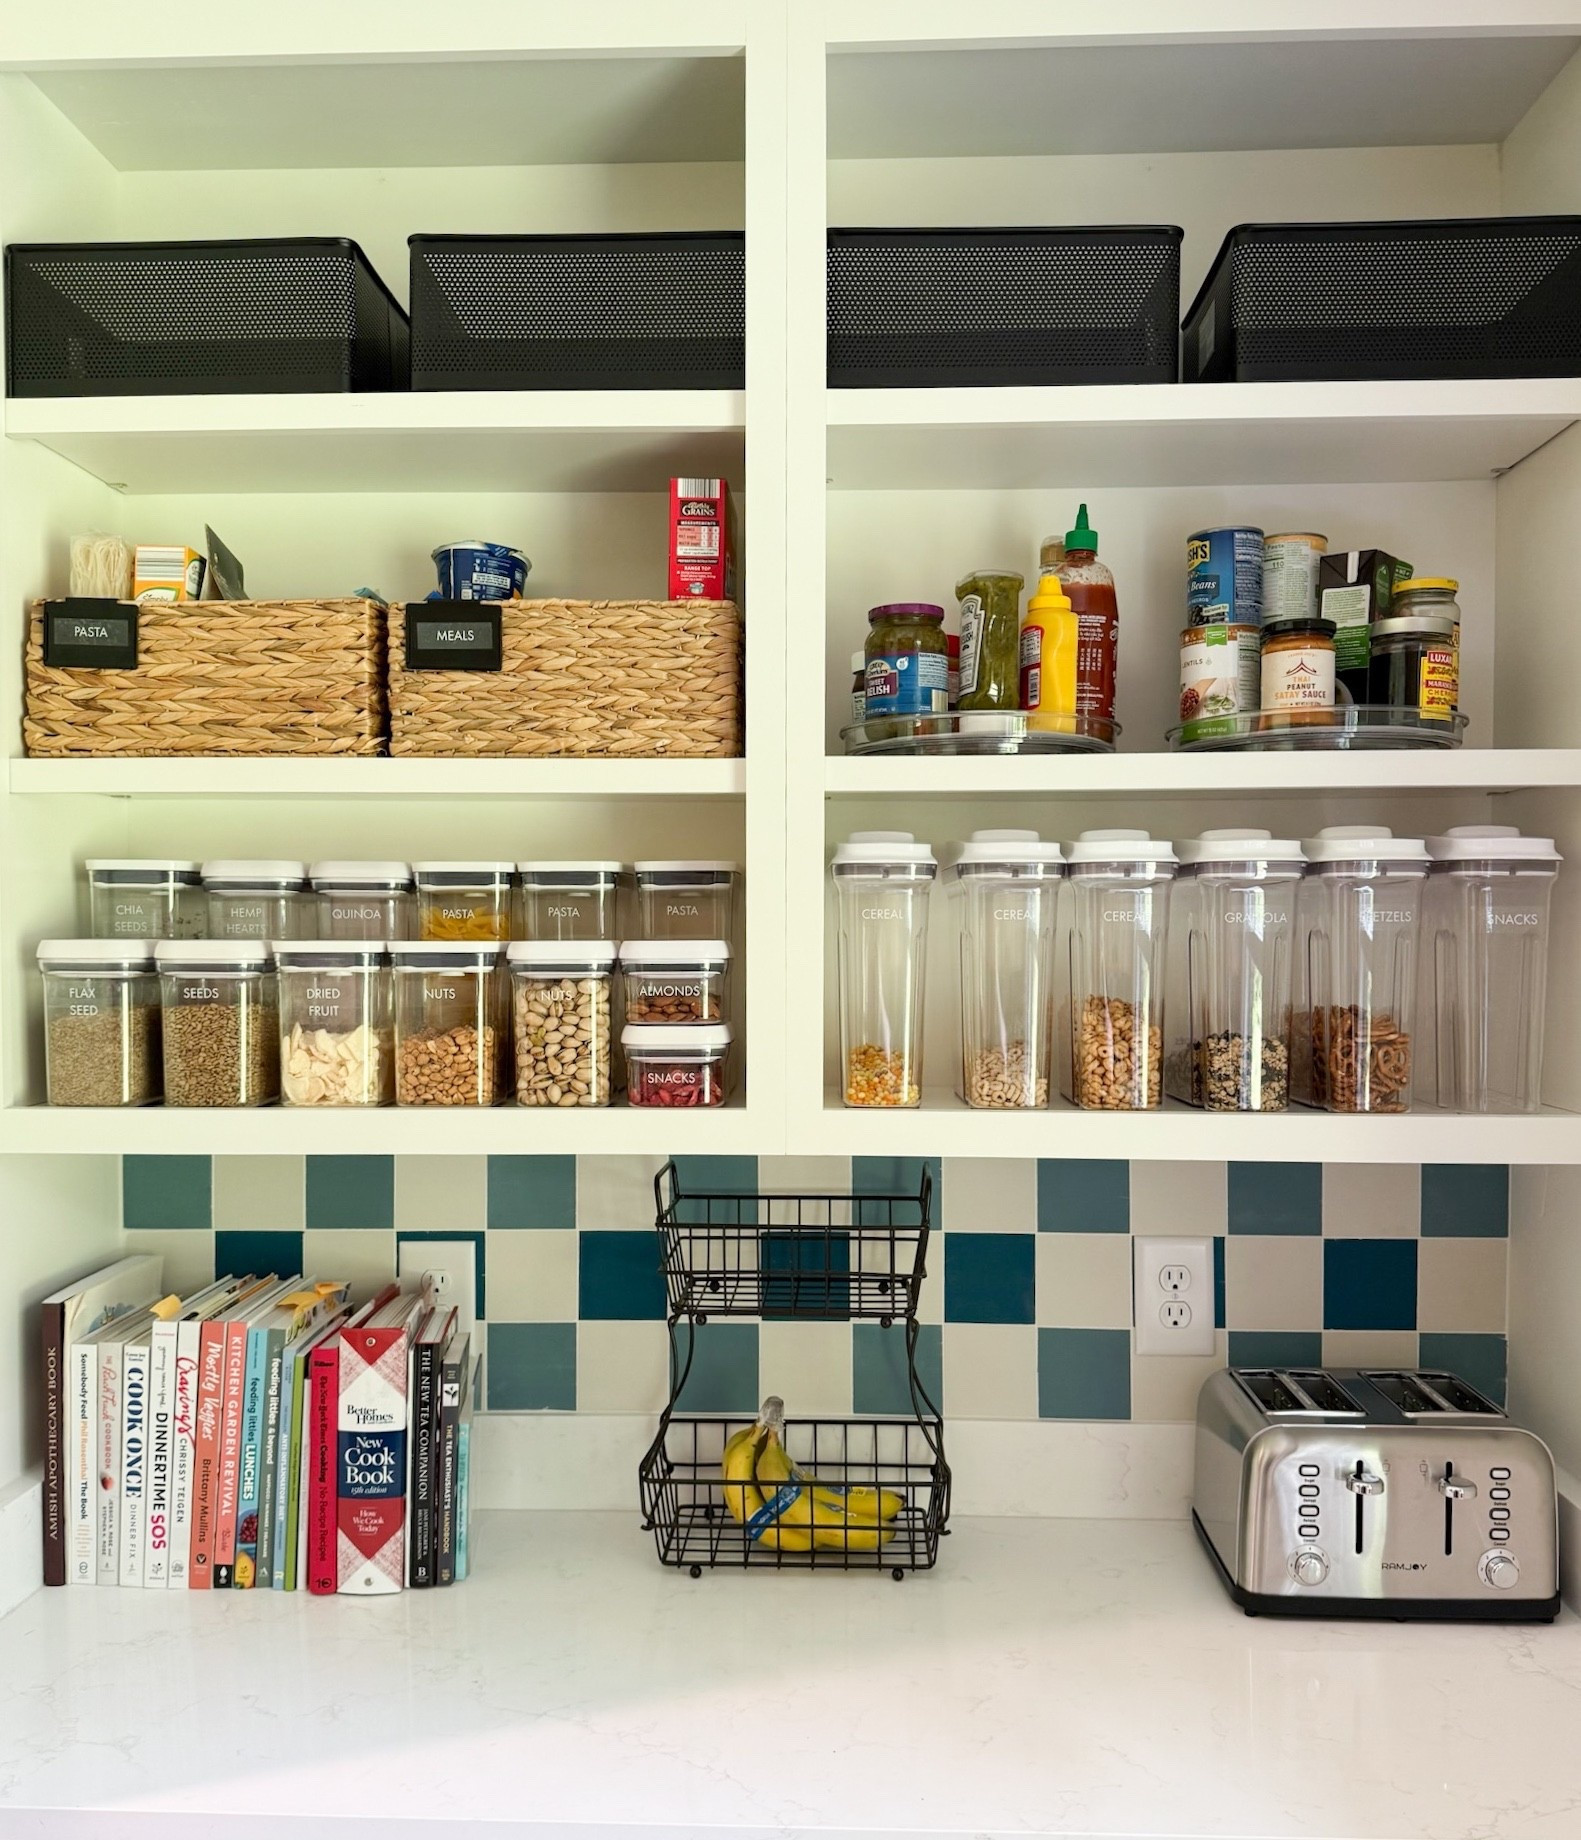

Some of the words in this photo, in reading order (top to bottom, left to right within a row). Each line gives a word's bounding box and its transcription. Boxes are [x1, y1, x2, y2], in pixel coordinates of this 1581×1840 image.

[1188, 544, 1208, 562] SH'S
[1191, 581, 1217, 592] Beans
[74, 626, 108, 638] PASTA
[436, 630, 475, 642] MEALS
[1274, 691, 1300, 700] SATAY
[1302, 690, 1327, 699] SAUCE
[116, 905, 143, 915] CHIA
[230, 907, 263, 918] HEMP
[332, 908, 381, 920] QUINOA
[442, 908, 475, 919] PASTA
[548, 907, 580, 917] PASTA
[666, 905, 698, 916] PASTA
[861, 908, 904, 920] CEREAL
[993, 909, 1037, 920] CEREA
[1103, 910, 1147, 921] CEREA
[1224, 911, 1288, 923] GRAOLA
[1361, 910, 1412, 922] ETZELS
[114, 921, 147, 932] SEEDS
[1487, 913, 1538, 925] SNACKS
[226, 923, 266, 935] HEARTS
[69, 988, 96, 999] FLAX
[183, 987, 219, 999] SEEDS
[306, 988, 341, 1000] DRIED
[425, 988, 456, 999] NUTS
[541, 990, 573, 1001] NUTS
[639, 985, 701, 997] ALMONDS
[69, 1005, 98, 1016] SEED
[308, 1005, 340, 1017] FRUIT
[647, 1072, 696, 1084] SNACKS
[47, 1346, 57, 1388] BOOK
[203, 1341, 223, 1391] Mostly
[229, 1336, 242, 1396] KITCHEN
[421, 1350, 431, 1373] THE
[80, 1353, 88, 1398] Somebody
[268, 1358, 281, 1395] feeding
[319, 1375, 329, 1389] The
[247, 1377, 260, 1413] feeding
[319, 1389, 328, 1405] New
[420, 1376, 430, 1403] NEW
[126, 1367, 144, 1433] COOK
[174, 1357, 198, 1448] Cravings
[80, 1399, 88, 1419] Feed
[267, 1397, 280, 1425] littles
[318, 1405, 328, 1423] York
[347, 1404, 378, 1416] Better
[419, 1406, 429, 1427] TEA
[199, 1397, 220, 1441] Veggies
[356, 1413, 394, 1425] Homes
[80, 1420, 88, 1436] Phil
[224, 1400, 239, 1456] GARDEN
[247, 1416, 258, 1442] littles
[319, 1423, 328, 1444] Times
[48, 1393, 58, 1490] APOTHECARY
[266, 1434, 275, 1464] beyond
[356, 1436, 383, 1449] New
[445, 1440, 453, 1456] TEA
[80, 1437, 88, 1480] Rosenthal
[153, 1412, 168, 1511] DINNERTIME
[178, 1438, 187, 1482] CHRISSY
[318, 1445, 329, 1483] Cooking
[344, 1446, 396, 1466] Cook
[125, 1437, 143, 1498] ONCE
[242, 1444, 256, 1500] LUNCHES
[418, 1429, 429, 1500] COMPANION
[199, 1458, 212, 1502] Brittany
[345, 1465, 395, 1485] Book
[80, 1481, 88, 1496] The
[221, 1460, 235, 1516] REVIVAL
[351, 1486, 364, 1495] 15th
[364, 1486, 387, 1494] edition
[443, 1457, 452, 1510] ENTHUSIAST'S
[80, 1497, 88, 1520] Book
[176, 1486, 186, 1523] TEIGEN
[49, 1493, 58, 1541] AMISH
[352, 1516, 364, 1524] We
[364, 1516, 384, 1524] Cook
[360, 1509, 376, 1517] How
[150, 1514, 166, 1550] SOS
[198, 1505, 209, 1543] Mullins
[357, 1524, 379, 1534] Today
[317, 1529, 328, 1562] Recipes
[1381, 1562, 1428, 1571] RAMJOY
